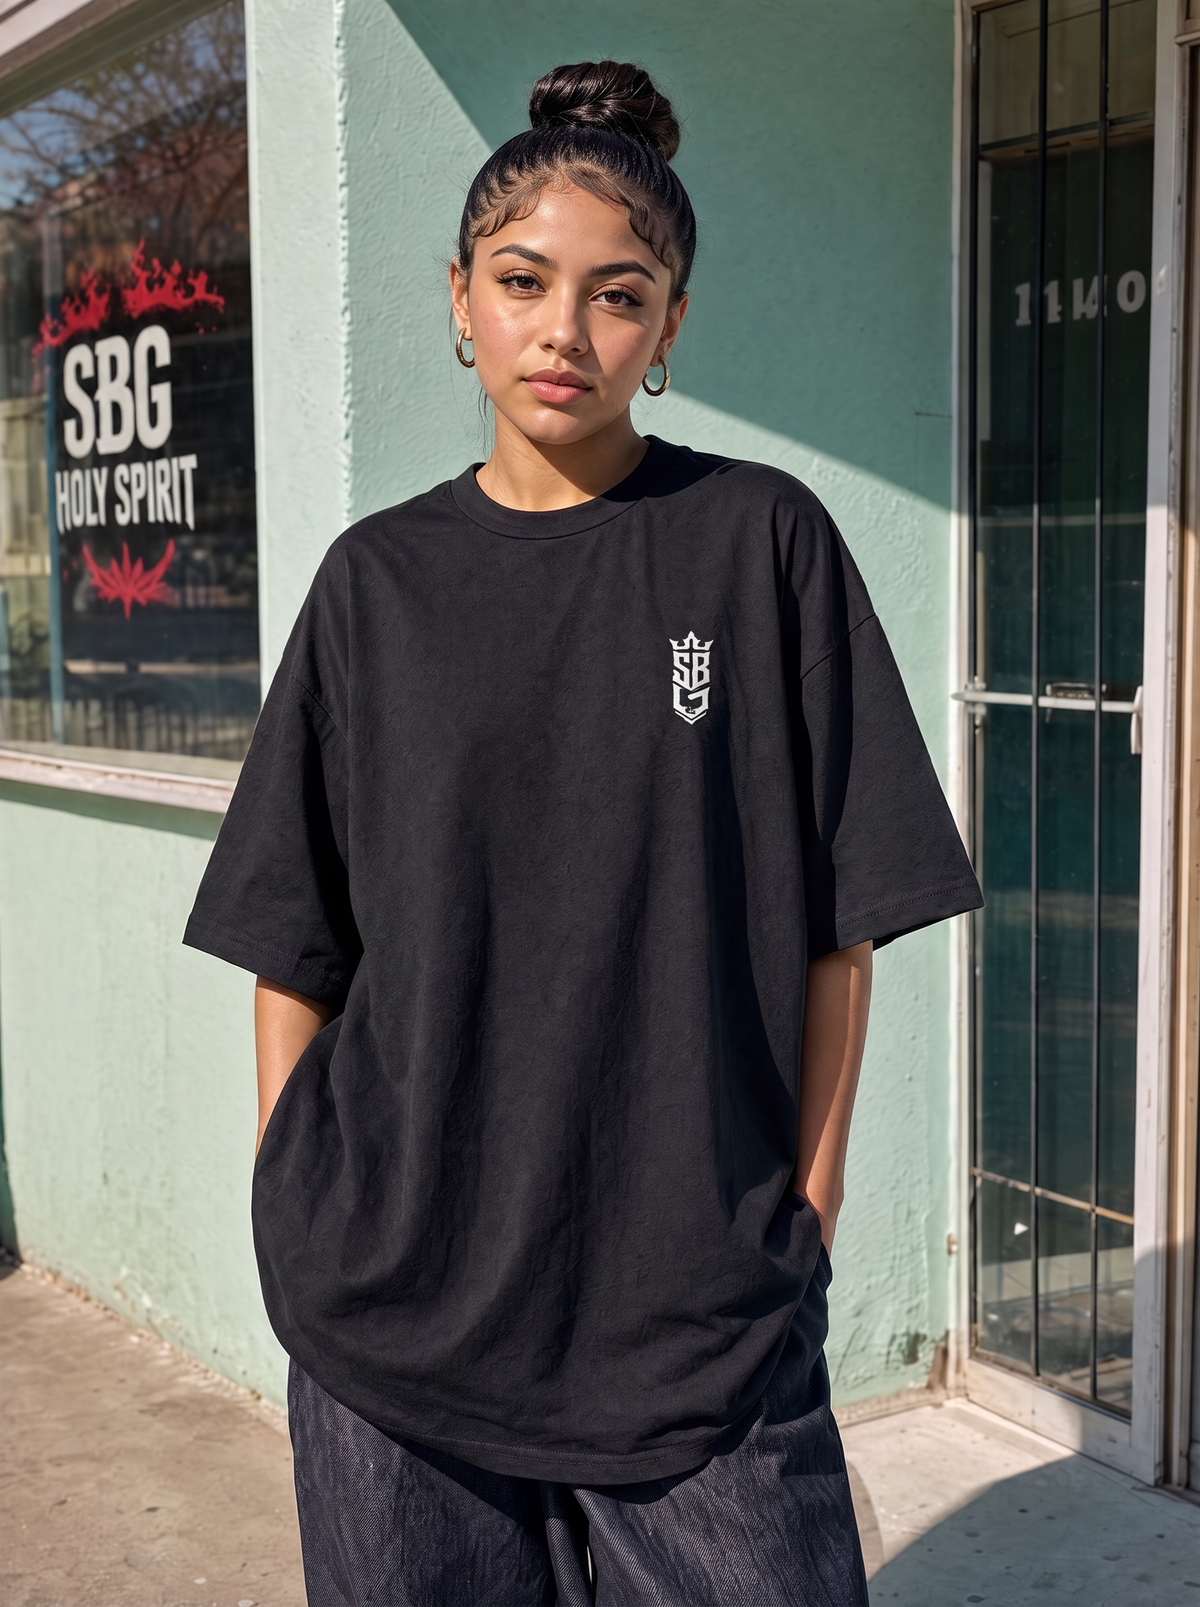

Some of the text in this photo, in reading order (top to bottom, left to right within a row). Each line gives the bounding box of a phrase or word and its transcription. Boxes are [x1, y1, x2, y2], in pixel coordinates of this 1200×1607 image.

[64, 325, 172, 458] SBG
[55, 454, 197, 534] HOLY SPIRIT
